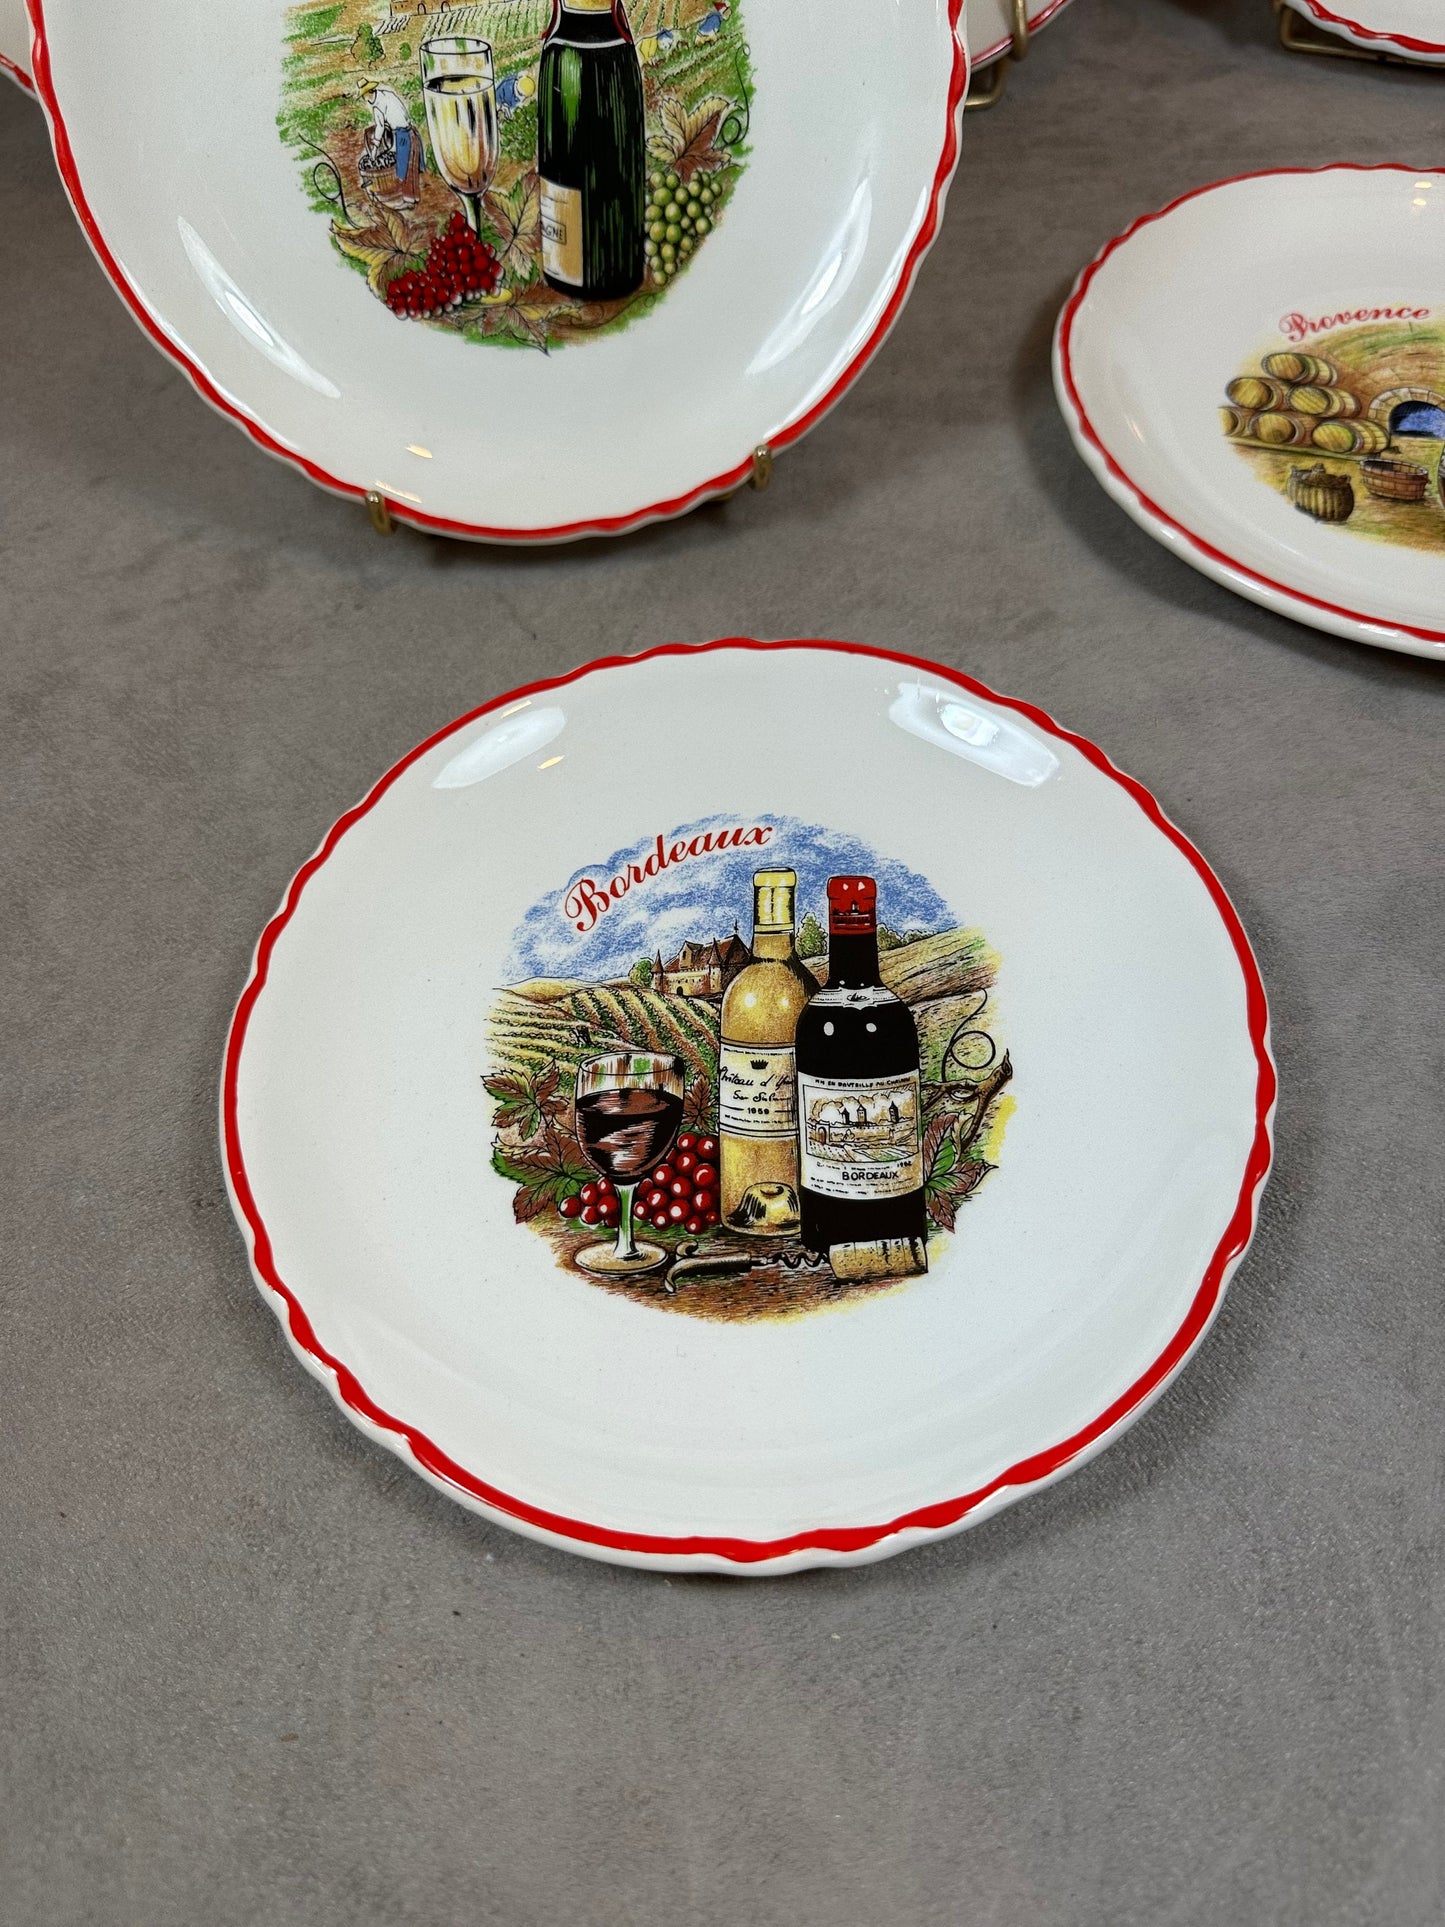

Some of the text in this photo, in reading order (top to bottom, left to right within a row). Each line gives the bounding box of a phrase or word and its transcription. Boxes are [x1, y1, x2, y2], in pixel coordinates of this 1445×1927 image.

[1278, 306, 1431, 343] Provence
[564, 825, 773, 932] Bordeaux
[841, 1171, 900, 1181] BORDEAUX
